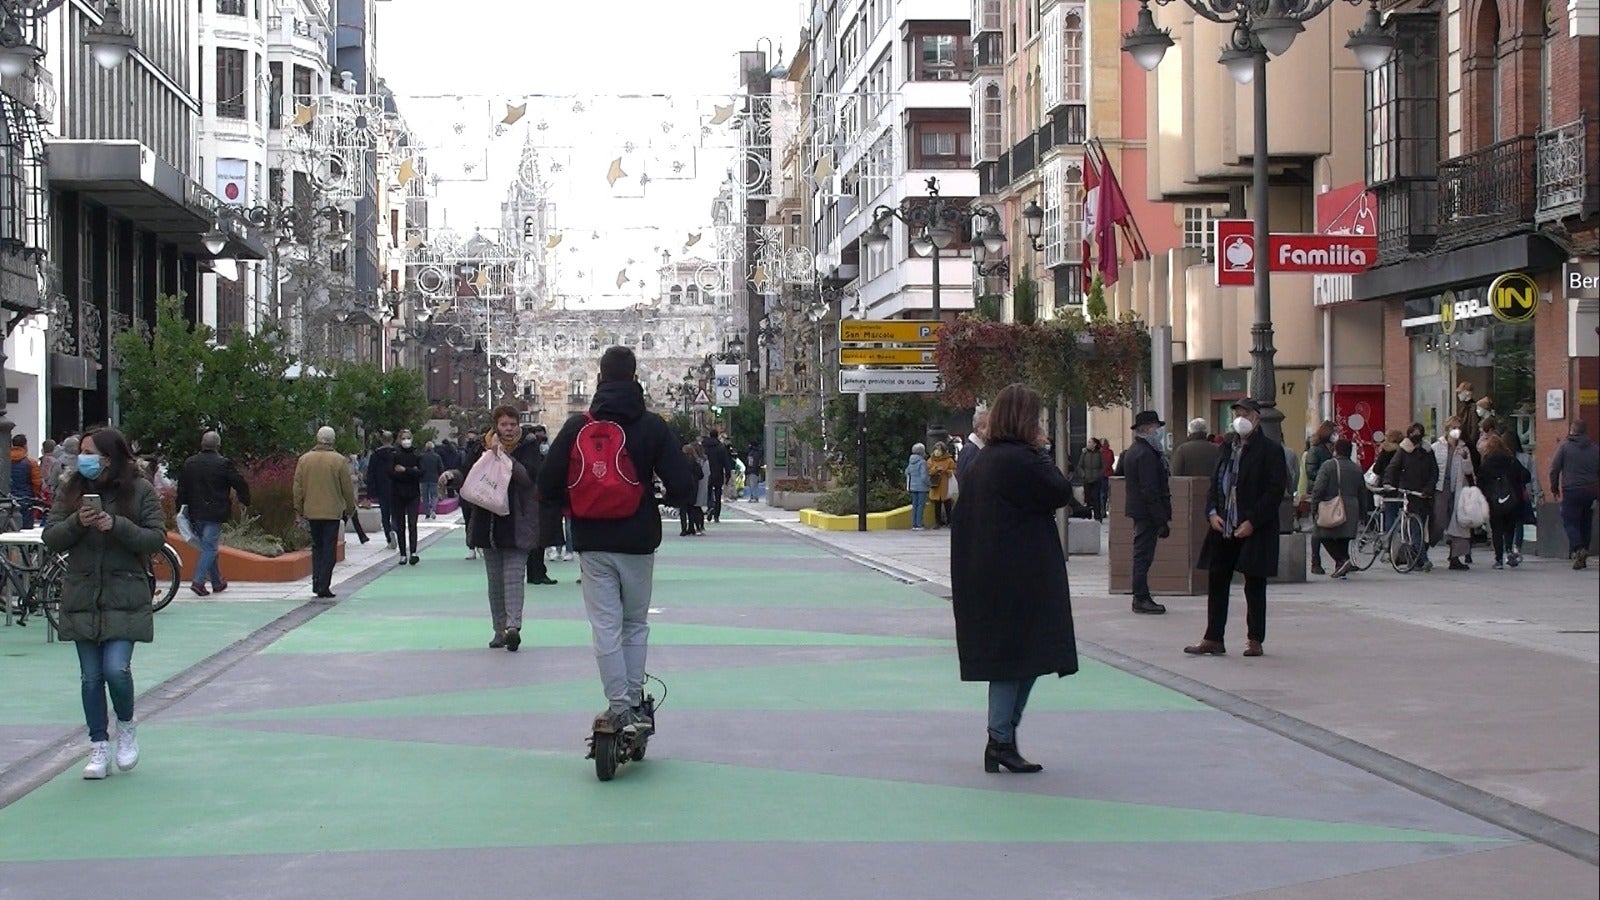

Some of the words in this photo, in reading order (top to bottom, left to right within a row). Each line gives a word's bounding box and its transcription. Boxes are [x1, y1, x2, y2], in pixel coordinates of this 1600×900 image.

[1570, 272, 1600, 289] Ber
[1497, 287, 1533, 309] IN
[845, 331, 860, 339] San
[1281, 382, 1295, 395] 17
